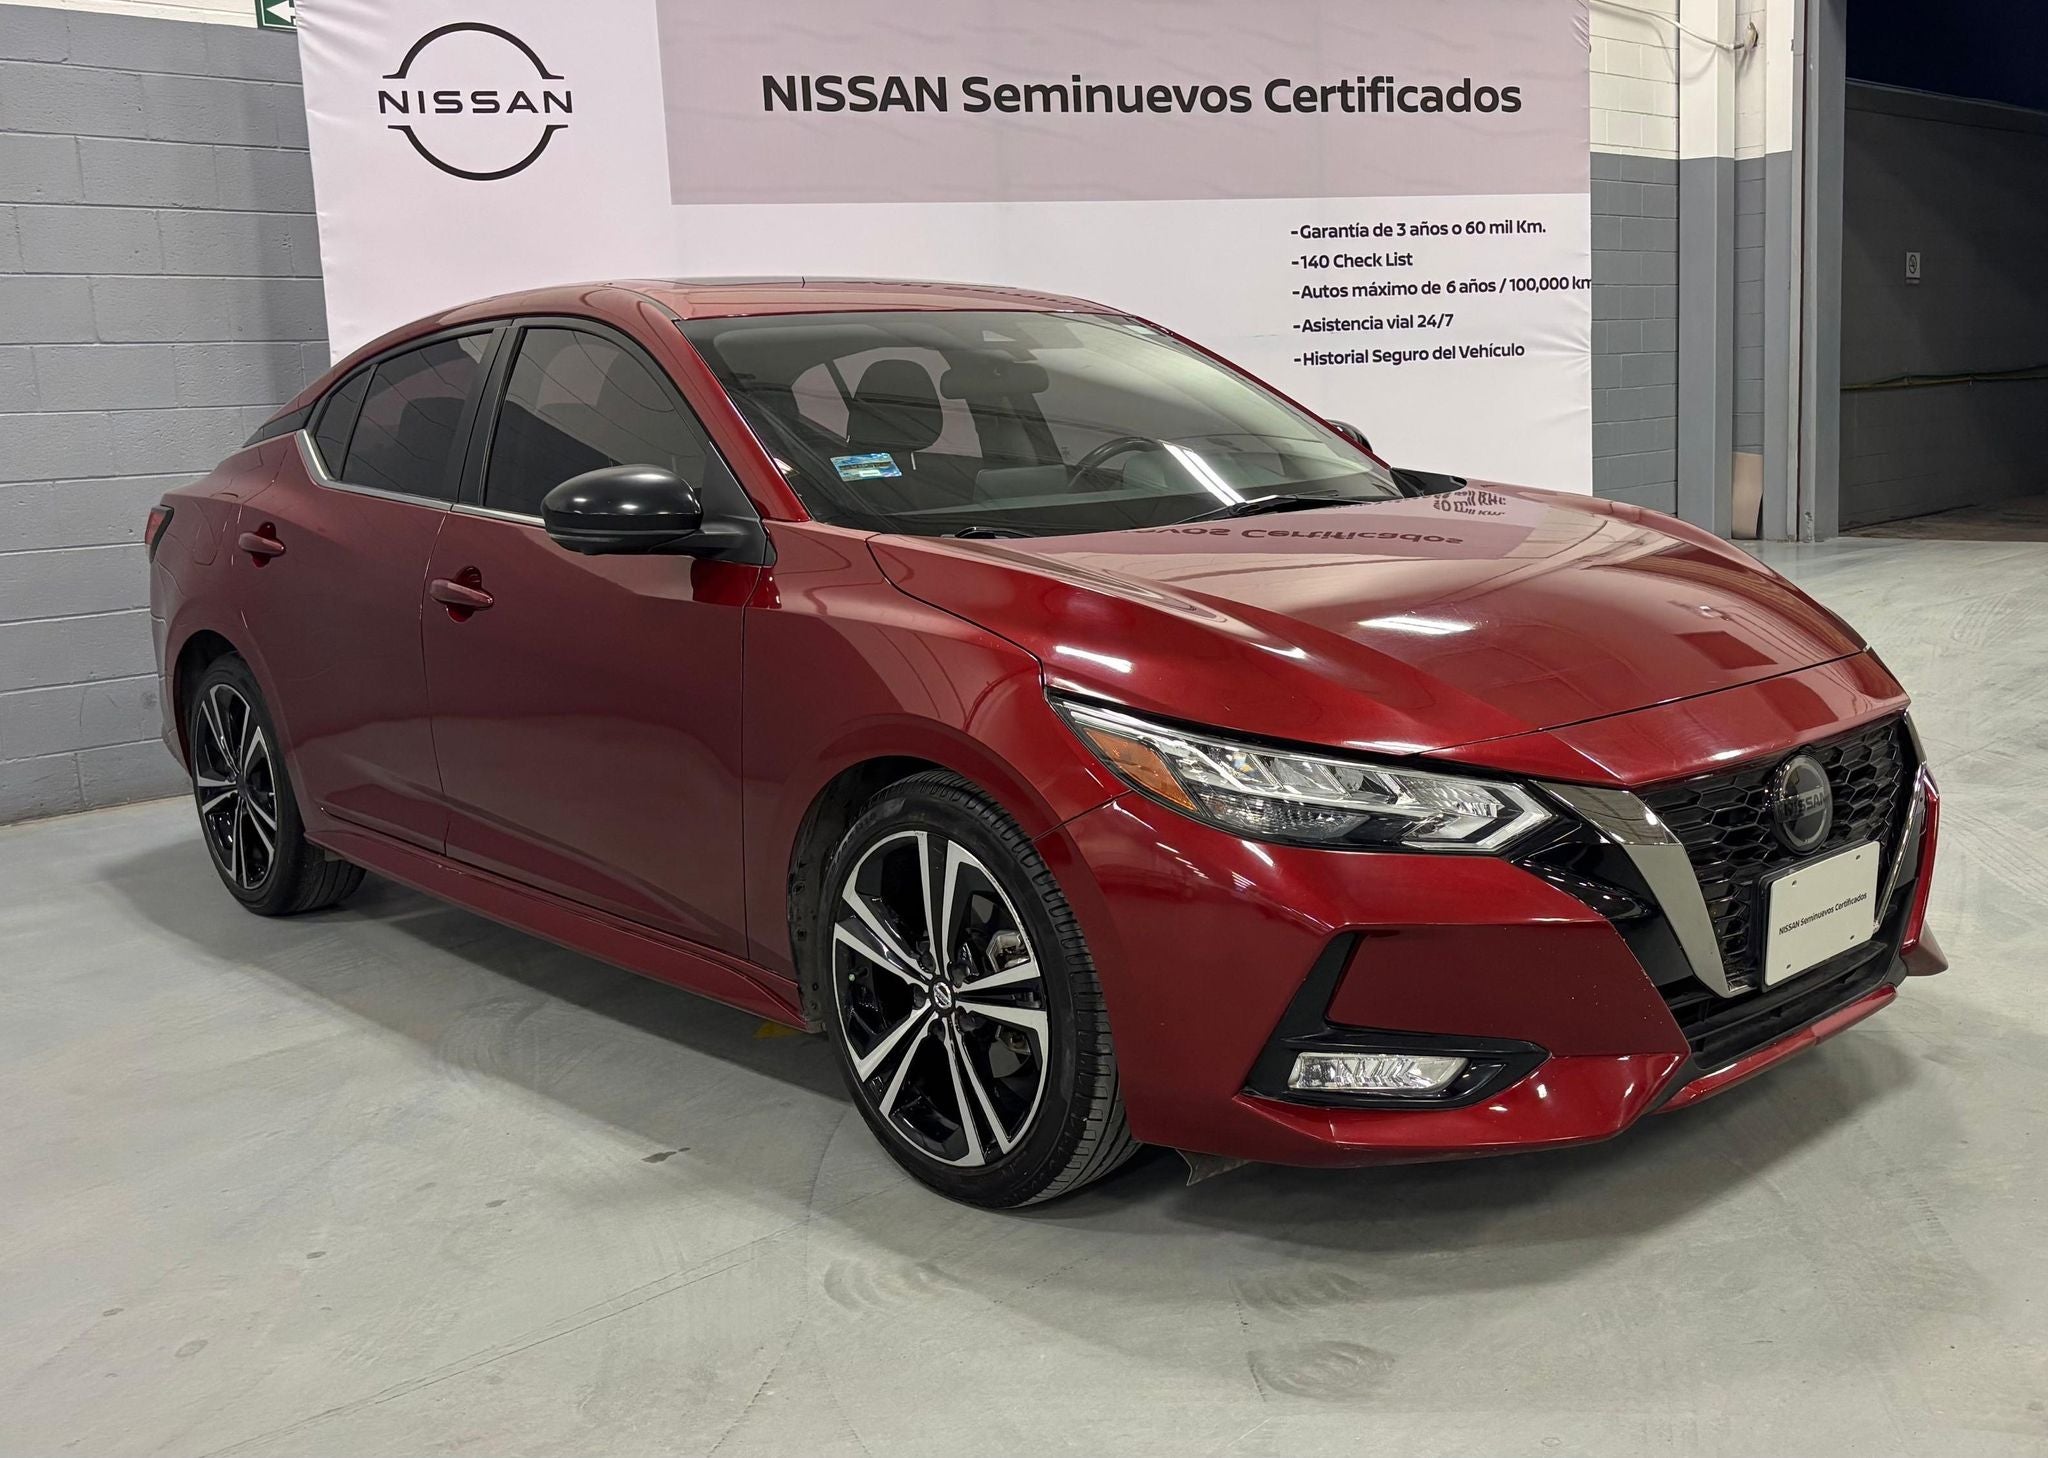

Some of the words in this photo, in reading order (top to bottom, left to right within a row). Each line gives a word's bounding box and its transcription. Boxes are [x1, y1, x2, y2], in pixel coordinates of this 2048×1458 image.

[378, 90, 573, 115] NISSAN
[762, 75, 948, 113] NISSAN
[961, 74, 1252, 114] Seminuevos
[1264, 75, 1522, 114] Certificados
[1290, 222, 1370, 239] -Garantía
[1372, 222, 1394, 238] de
[1396, 222, 1407, 237] 3
[1409, 220, 1449, 237] años
[1451, 223, 1463, 236] o
[1465, 220, 1486, 235] 60
[1489, 219, 1513, 235] mil
[1516, 219, 1547, 234] Km.
[1291, 254, 1330, 270] -140
[1333, 252, 1383, 269] Check
[1385, 251, 1414, 267] List
[1292, 284, 1349, 299] -Autos
[1352, 281, 1418, 298] máximo
[1420, 280, 1442, 295] de
[1446, 279, 1457, 294] 6
[1458, 277, 1497, 294] años
[1499, 277, 1507, 294] /
[1509, 276, 1570, 294] 100,000
[1292, 316, 1384, 333] -Asistencia
[1386, 314, 1414, 330] vial
[1417, 313, 1454, 329] 24/7
[1293, 348, 1369, 366] -Historial
[1372, 347, 1430, 366] Seguro
[1432, 345, 1456, 360] del
[1458, 342, 1525, 359] Vehículo
[1778, 920, 1800, 935] NISSAN
[1800, 907, 1834, 926] Seminuevos
[1835, 893, 1867, 911] Certificados
